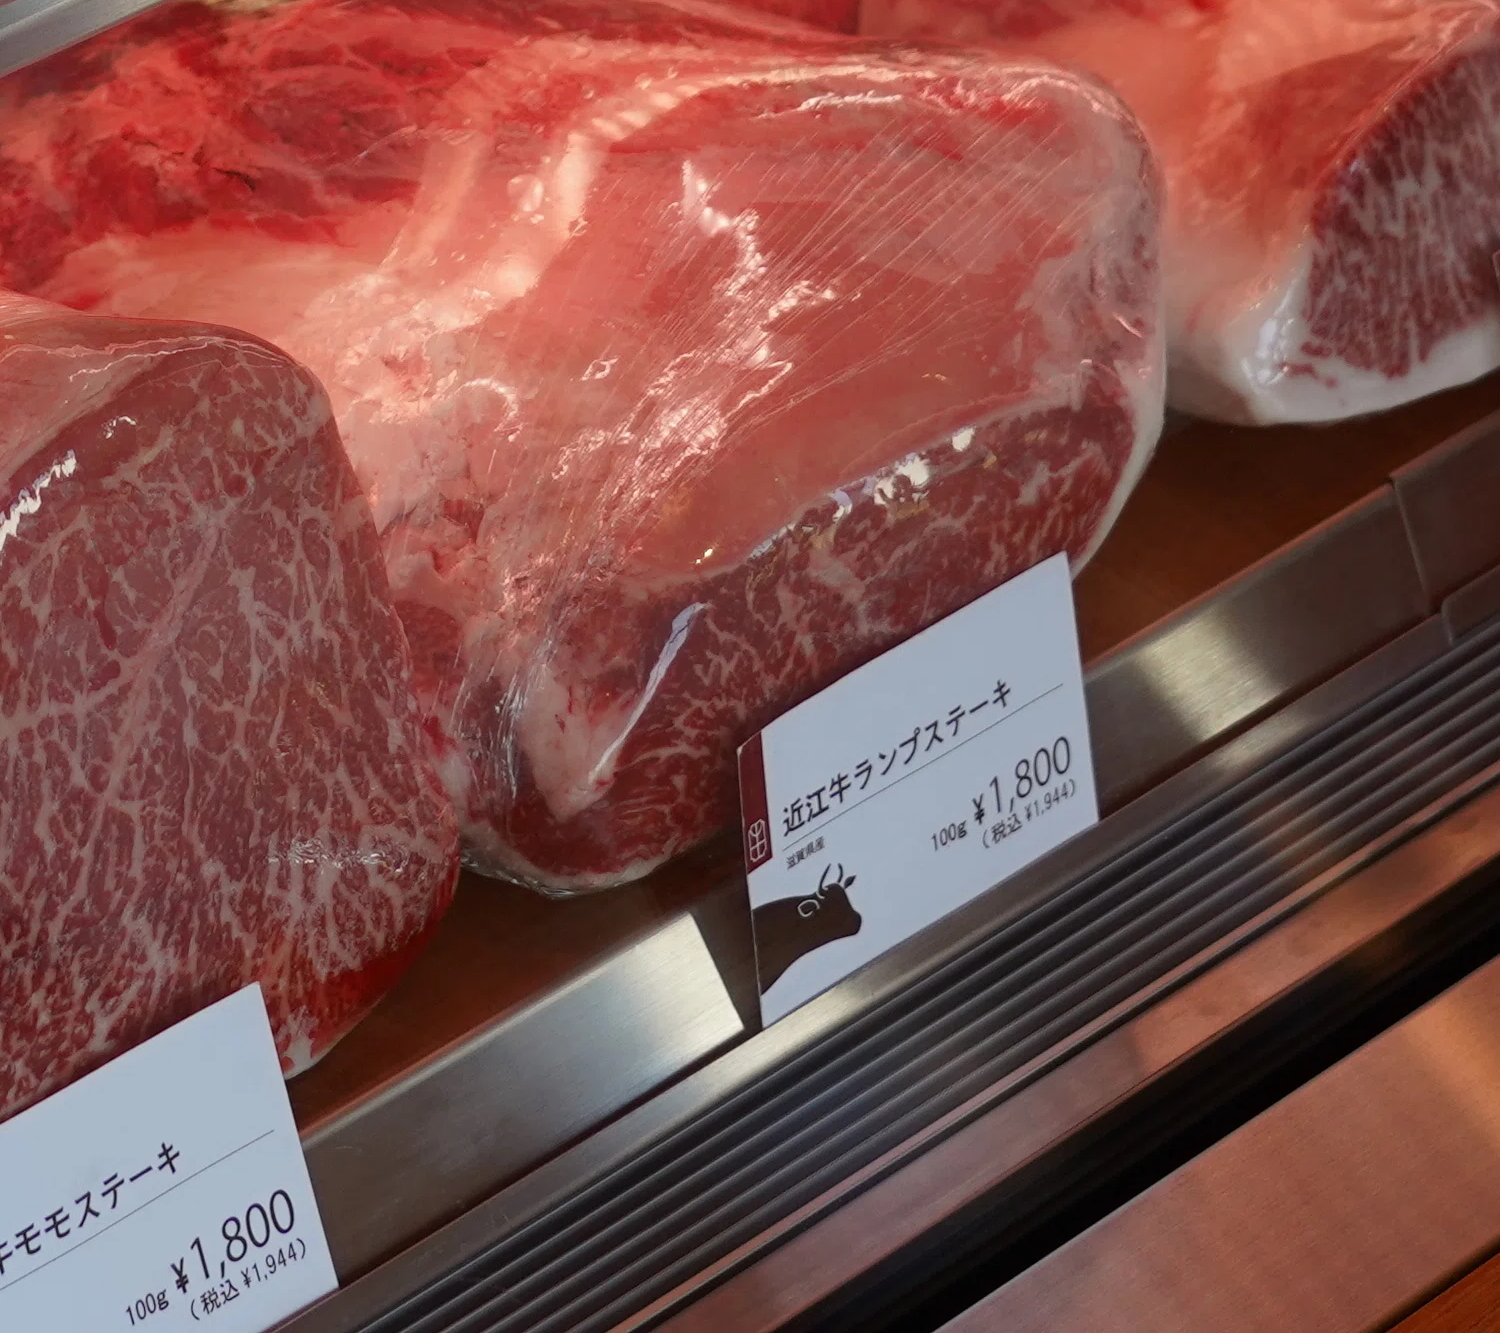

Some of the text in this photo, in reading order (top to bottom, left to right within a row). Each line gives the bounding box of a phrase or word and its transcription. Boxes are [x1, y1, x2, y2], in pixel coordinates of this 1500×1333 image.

[782, 679, 1011, 836] 近江牛ランプステーキ
[931, 736, 1072, 851] 100g ¥1,800
[982, 779, 1076, 849] (税込 ¥1,944)
[126, 1190, 295, 1326] 100g ¥1,800
[190, 1239, 307, 1321] (税込 ¥1,944)
